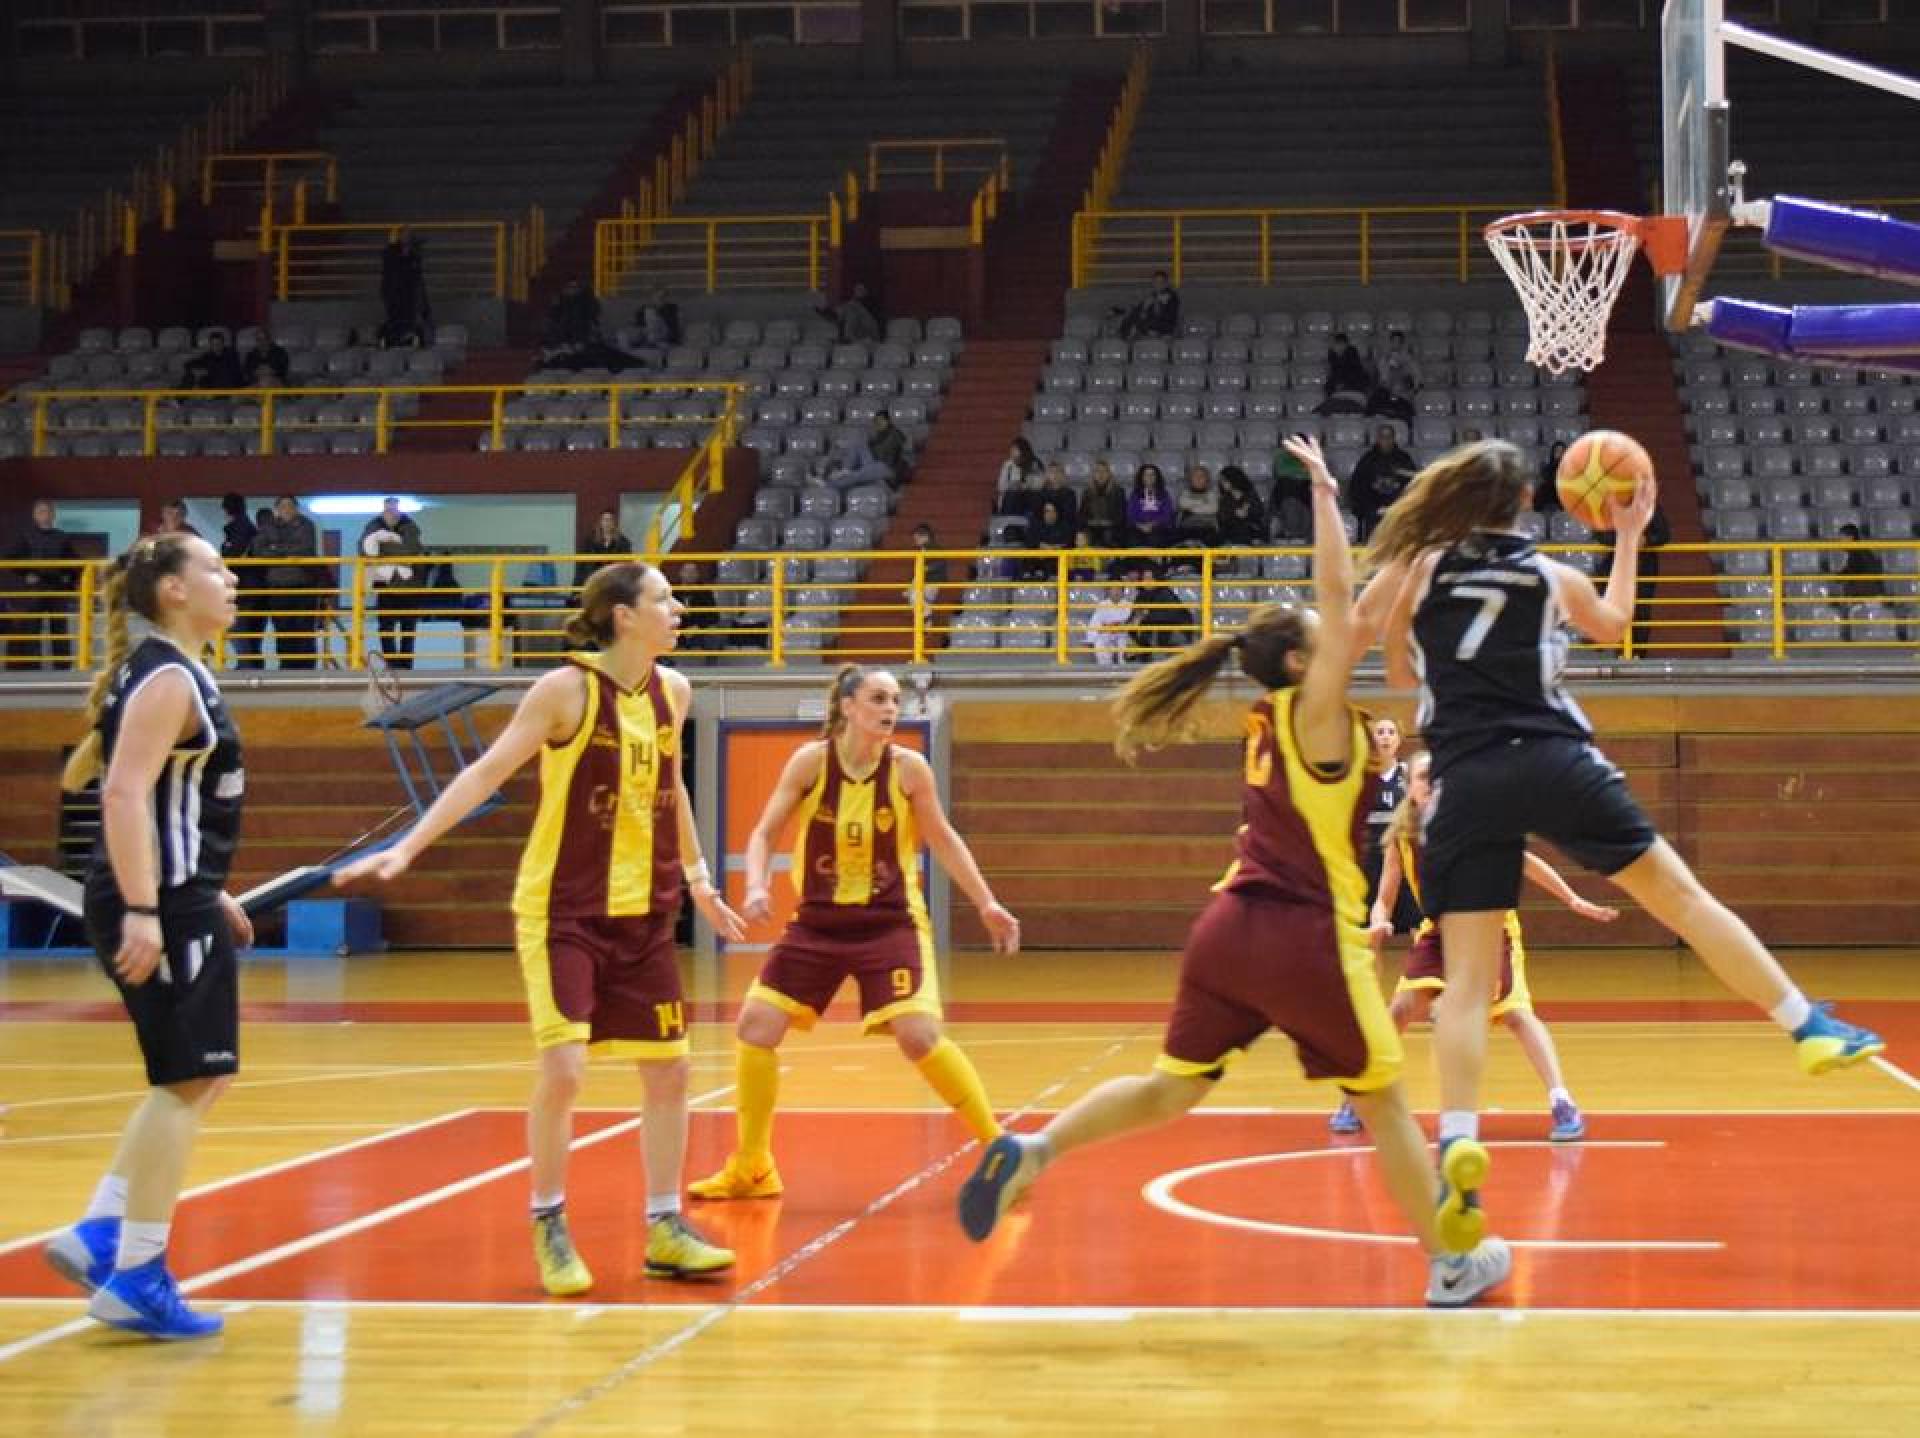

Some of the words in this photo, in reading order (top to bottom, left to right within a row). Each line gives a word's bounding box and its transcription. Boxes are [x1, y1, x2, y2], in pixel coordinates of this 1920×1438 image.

[1449, 587, 1507, 660] 7
[629, 743, 653, 776] 14
[1382, 791, 1393, 807] 4
[847, 821, 863, 849] 9
[891, 968, 912, 996] 9
[653, 1001, 683, 1038] 14
